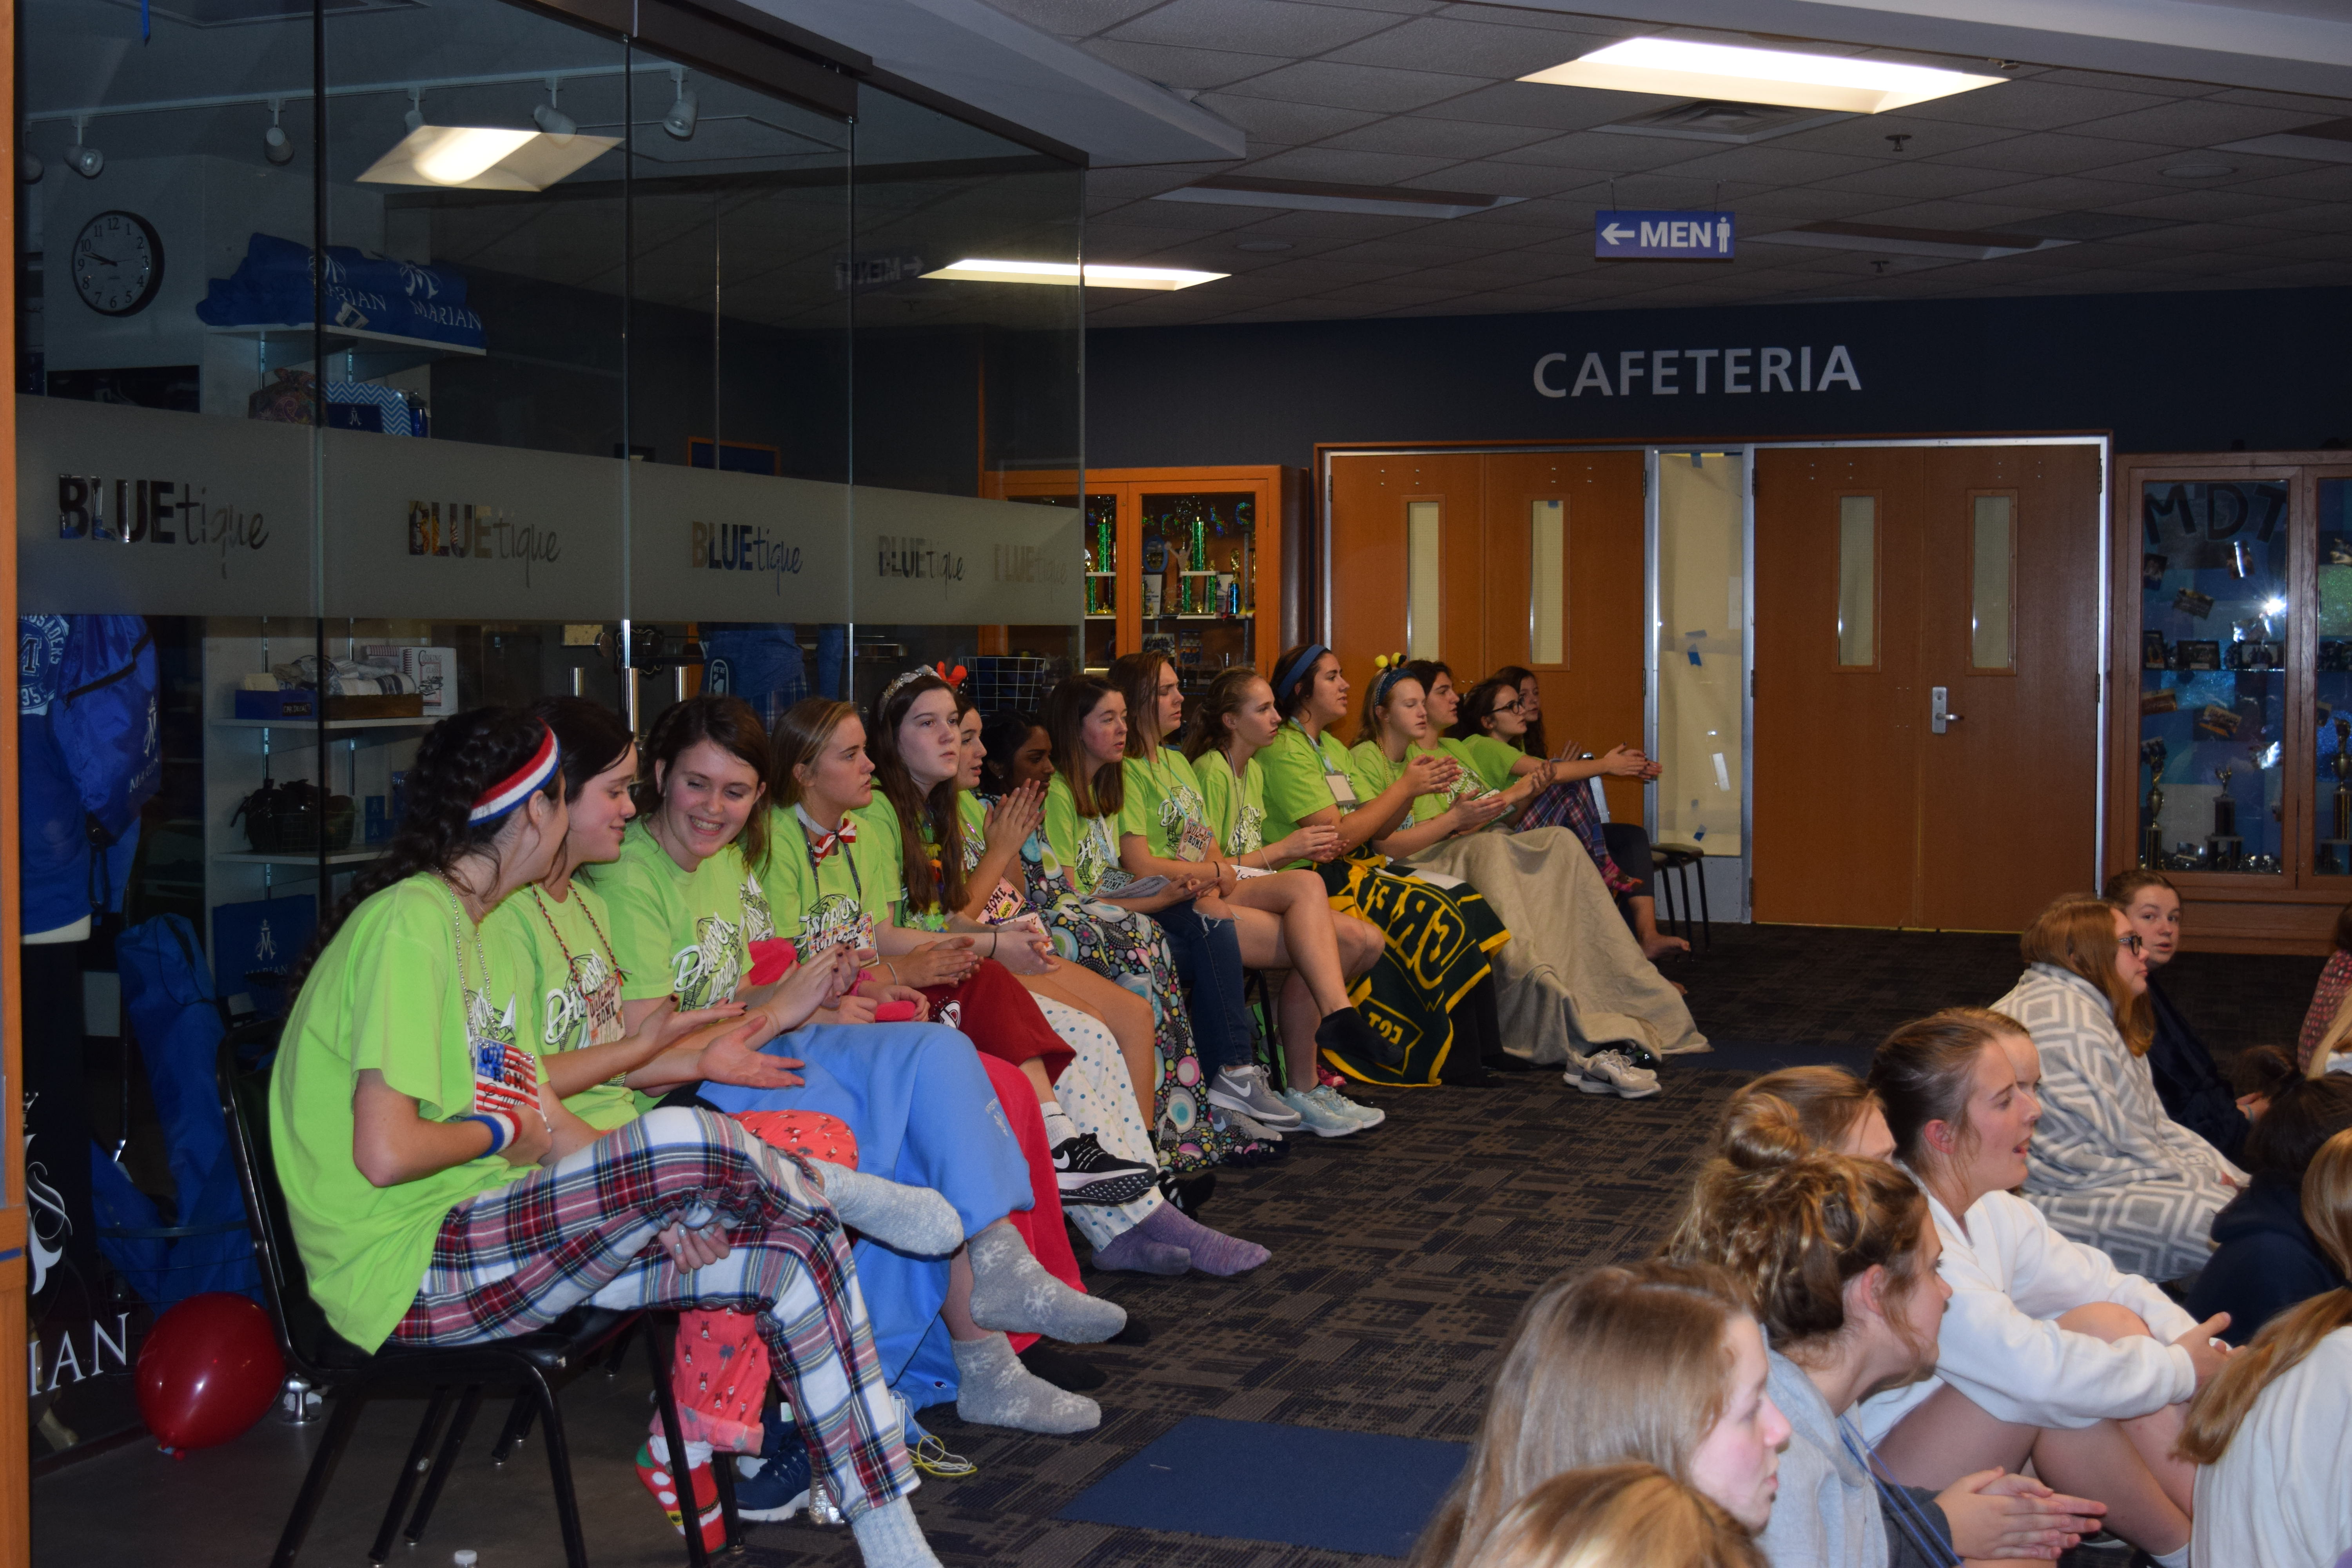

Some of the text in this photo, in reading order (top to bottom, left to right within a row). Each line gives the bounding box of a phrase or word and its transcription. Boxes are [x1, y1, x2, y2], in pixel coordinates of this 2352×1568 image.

[108, 218, 119, 230] 12
[127, 223, 131, 235] 1
[94, 225, 103, 237] 11
[1640, 221, 1711, 247] MEN
[81, 239, 91, 252] 10
[137, 236, 144, 249] 2
[78, 259, 85, 271] 9
[142, 255, 149, 269] 3
[82, 276, 89, 289] 8
[137, 275, 144, 287] 4
[95, 292, 102, 304] 7
[110, 296, 117, 308] 6
[125, 290, 132, 303] 5
[409, 299, 481, 331] MARIAN
[1533, 345, 1862, 398] CAFETERIA
[60, 474, 269, 579] BLUEtique
[409, 500, 561, 588] BLUEtique
[692, 521, 803, 596] BLUEtique
[878, 535, 965, 600] BLUEtique
[419, 650, 442, 666] COOKING
[1188, 835, 1203, 850] HOME
[984, 886, 1007, 915] HOME
